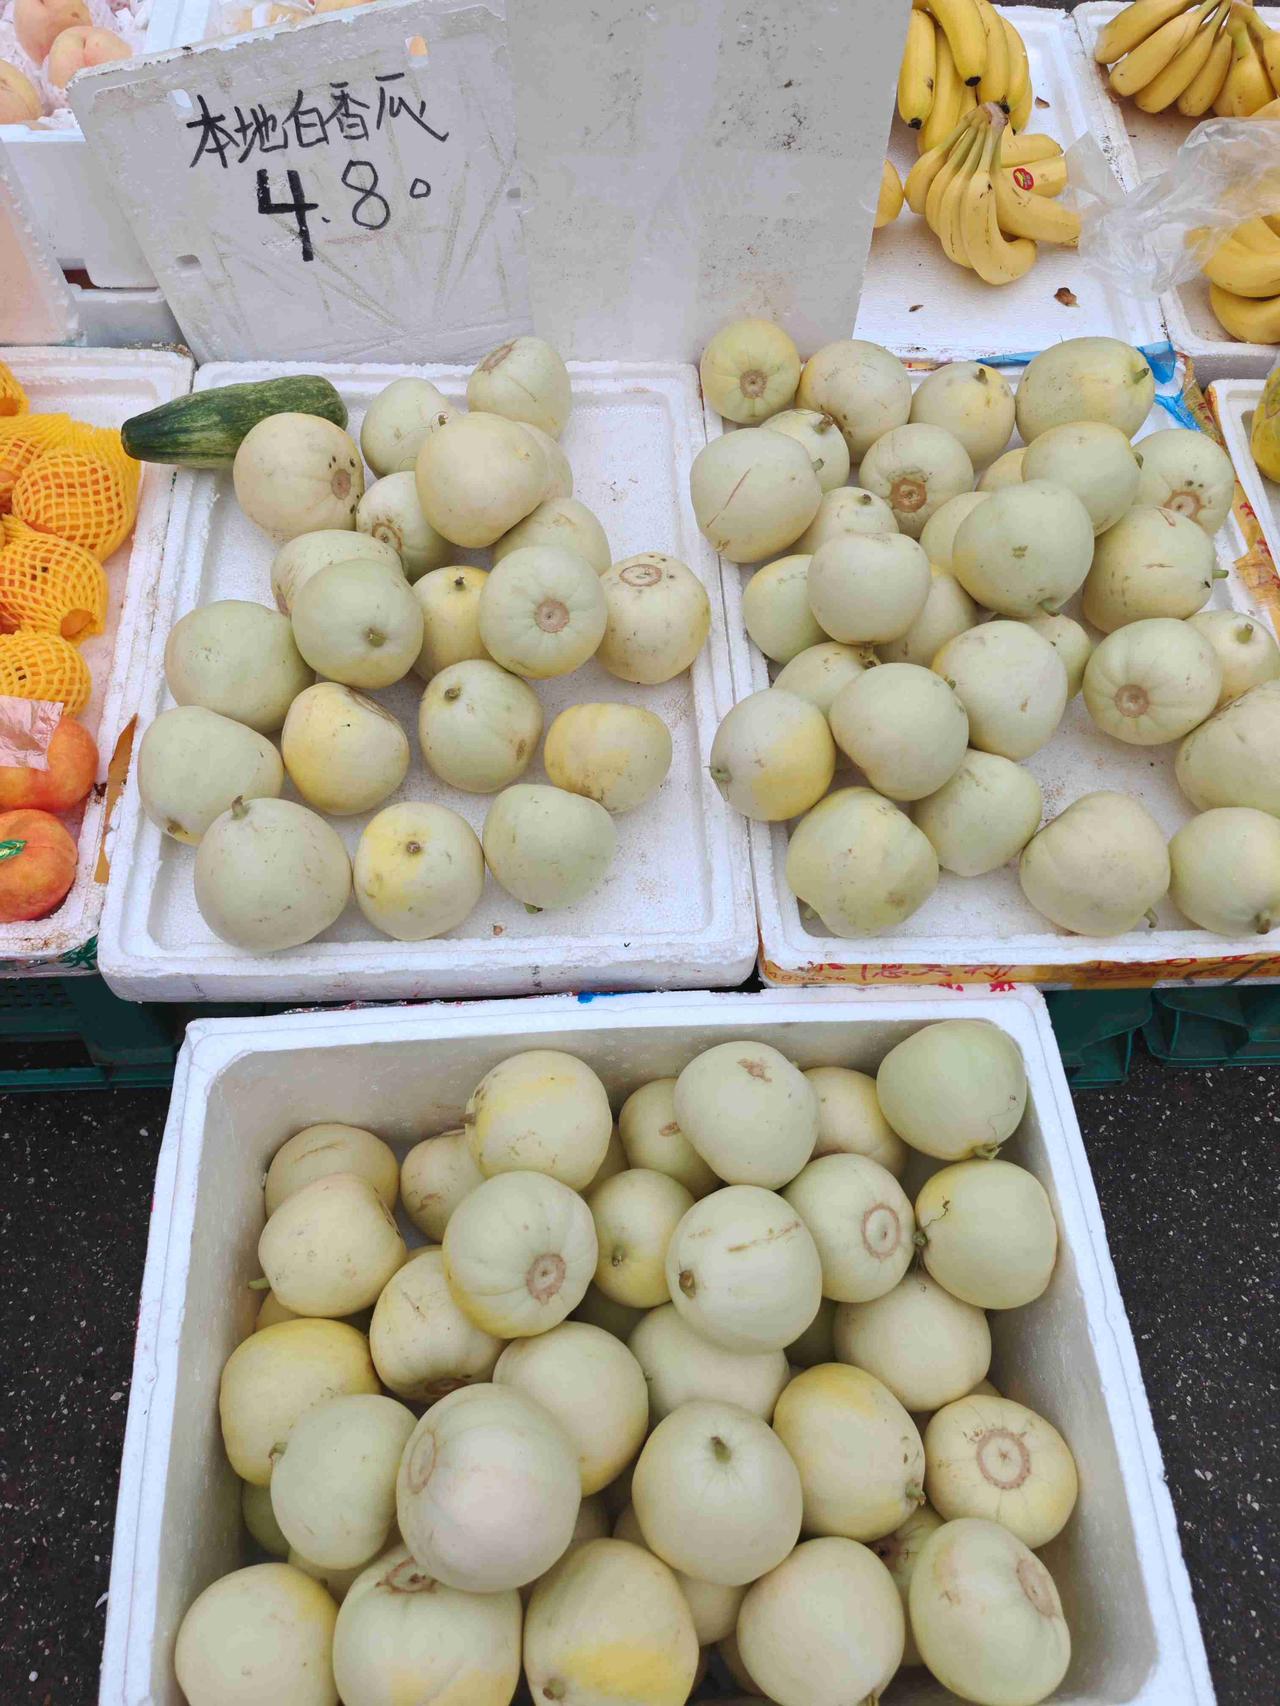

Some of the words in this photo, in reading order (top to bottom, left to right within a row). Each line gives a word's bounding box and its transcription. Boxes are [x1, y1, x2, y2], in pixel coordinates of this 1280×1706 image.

[186, 73, 449, 168] 本地白香瓜
